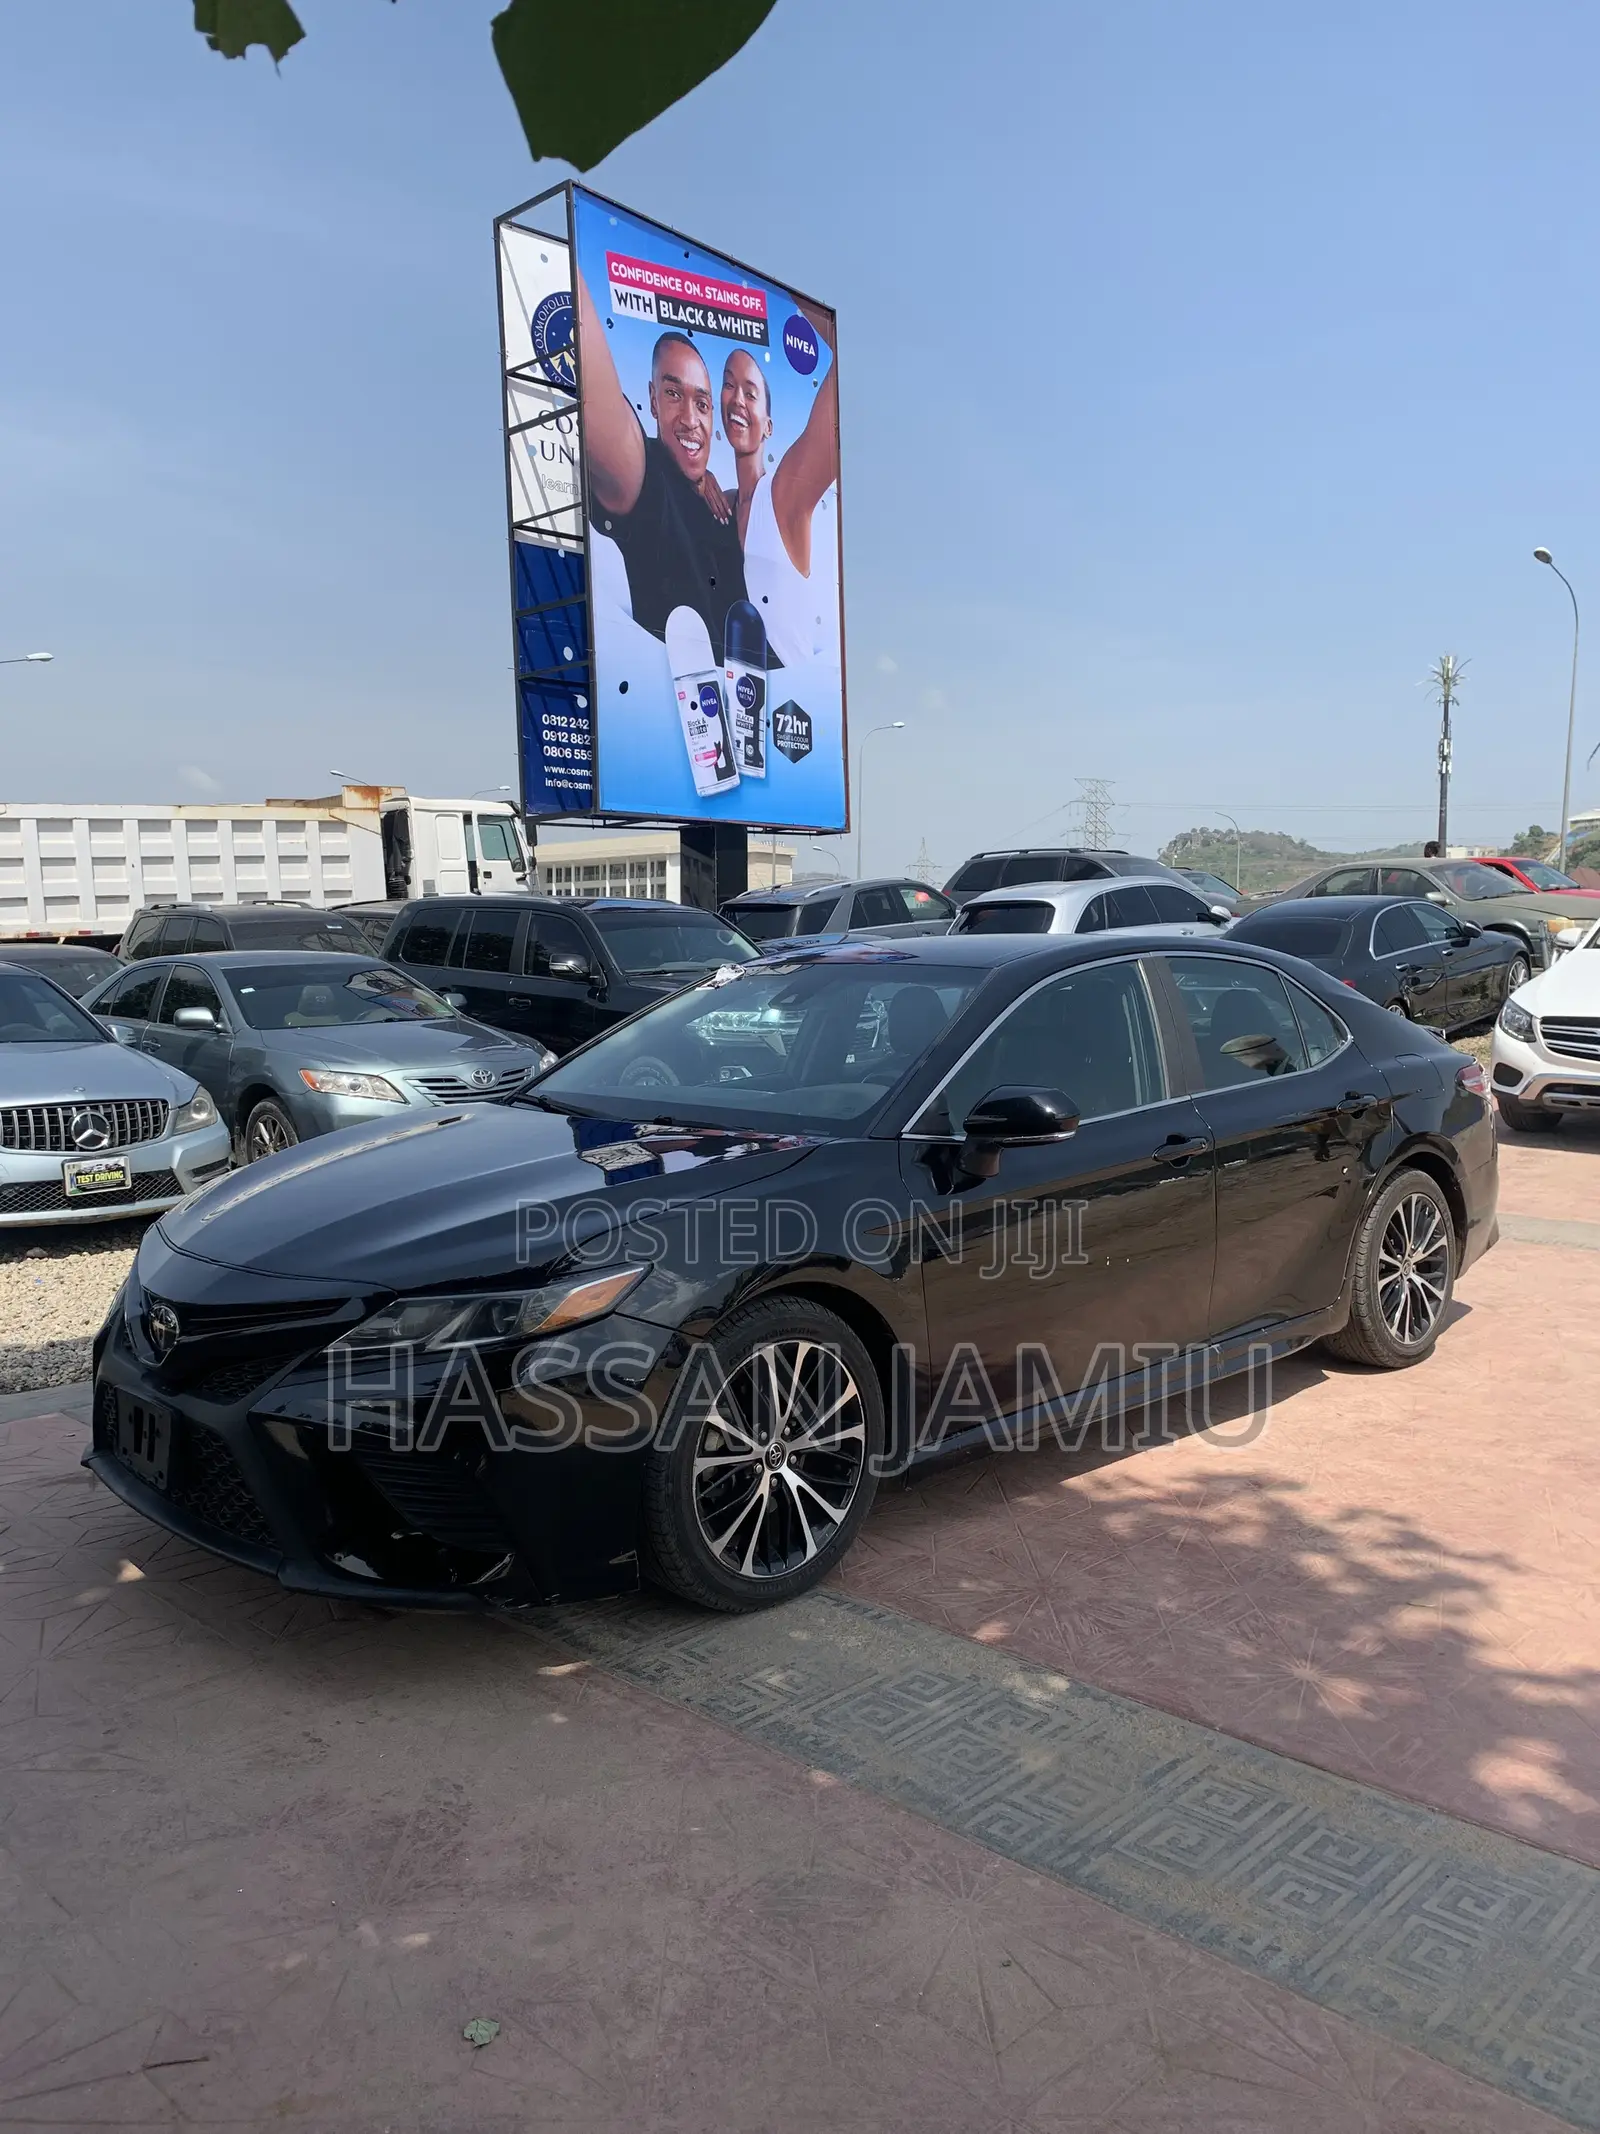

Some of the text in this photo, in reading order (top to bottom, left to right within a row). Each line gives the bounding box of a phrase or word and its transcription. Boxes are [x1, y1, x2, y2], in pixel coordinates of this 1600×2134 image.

[611, 261, 763, 312] CONFIDENCE ON. STAINS OFF.
[614, 289, 653, 314] WITH
[659, 300, 705, 327] BLACK
[707, 311, 718, 330] &
[786, 333, 816, 357] NIVEA
[737, 684, 754, 696] NIVEA
[701, 698, 717, 708] NIVEA
[542, 713, 590, 730] 0812 242
[776, 713, 809, 736] 72hr
[542, 729, 591, 746] 0912 882
[776, 739, 810, 751] PROTECTION
[543, 745, 572, 759] 0806
[76, 1170, 124, 1184] TEST DRIVING
